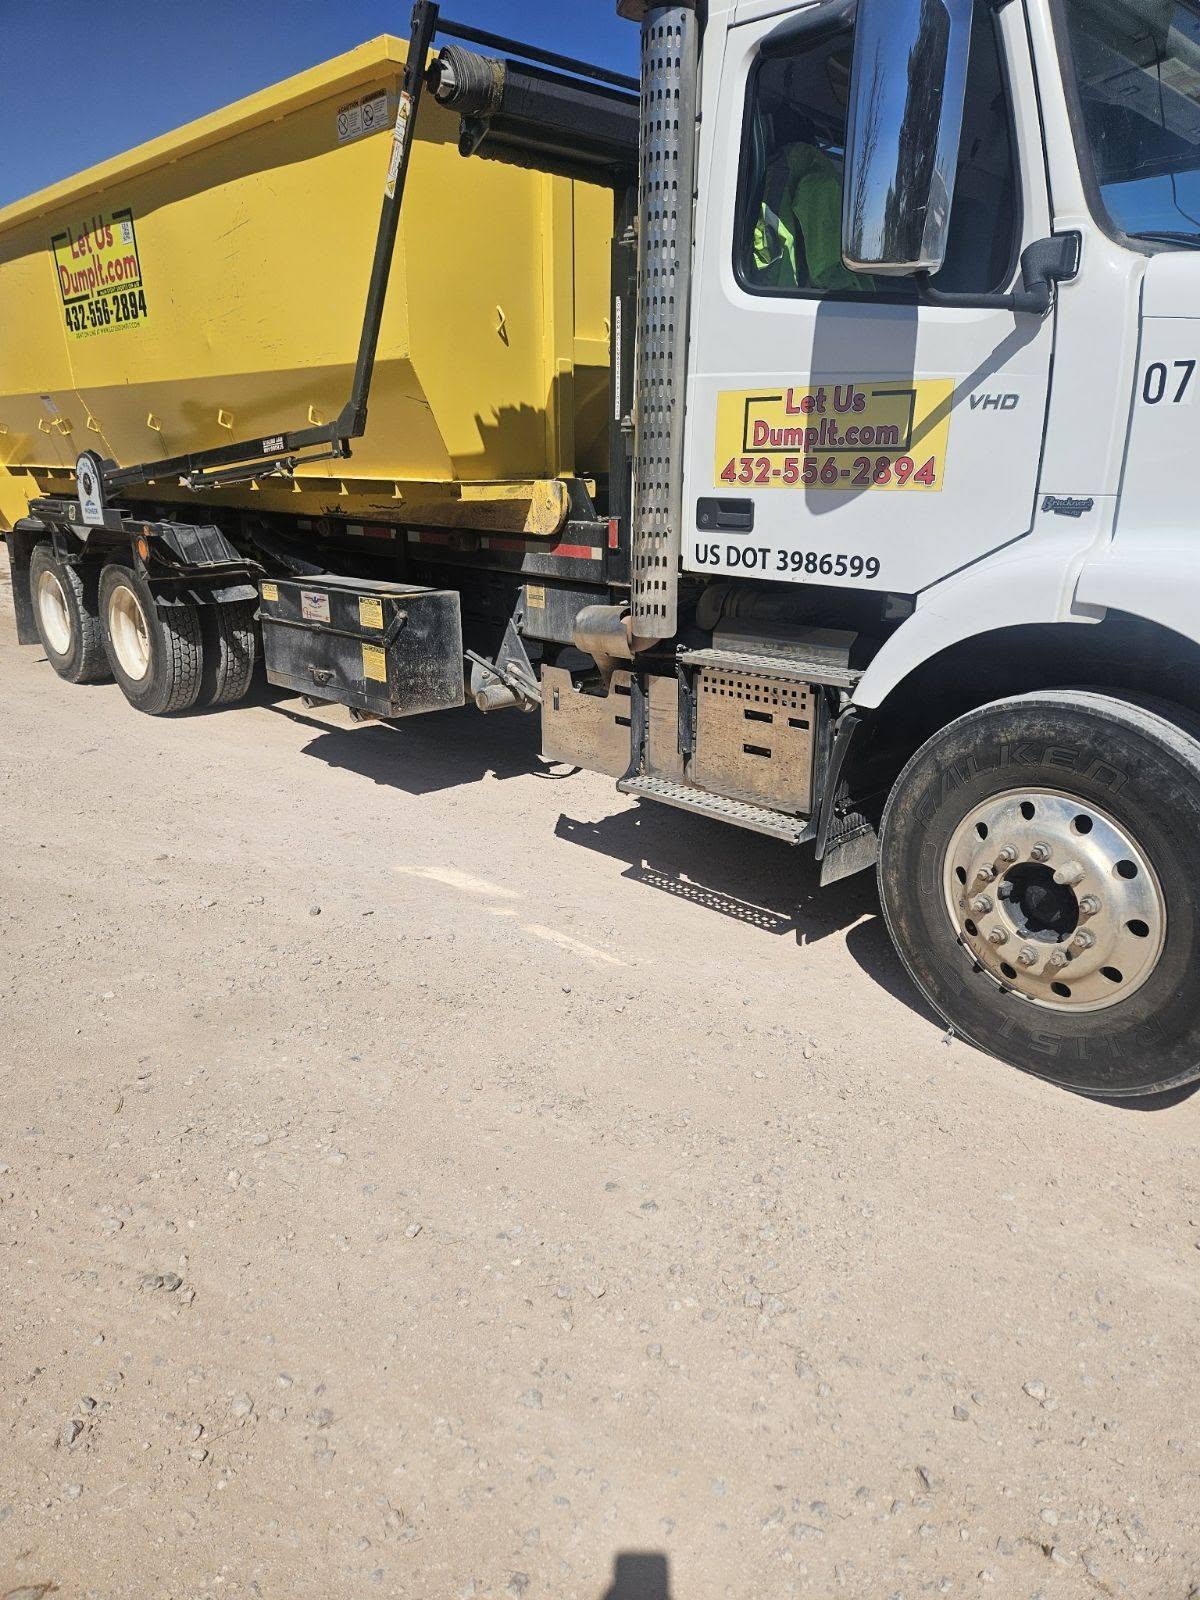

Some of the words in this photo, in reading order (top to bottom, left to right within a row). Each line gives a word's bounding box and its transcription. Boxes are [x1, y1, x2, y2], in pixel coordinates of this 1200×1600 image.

[67, 221, 92, 260] Let
[92, 213, 114, 251] Us
[59, 253, 138, 298] DumpIt.com
[64, 289, 148, 332] 432-556-2894
[785, 387, 827, 415] Let
[833, 384, 867, 414] Us
[1142, 359, 1197, 405] 07
[969, 393, 1020, 411] VHD
[752, 417, 900, 454] DumpIt.com
[720, 455, 936, 485] 432-556-2894
[695, 543, 721, 565] US
[726, 545, 771, 570] DOT
[776, 549, 881, 579] 3986599
